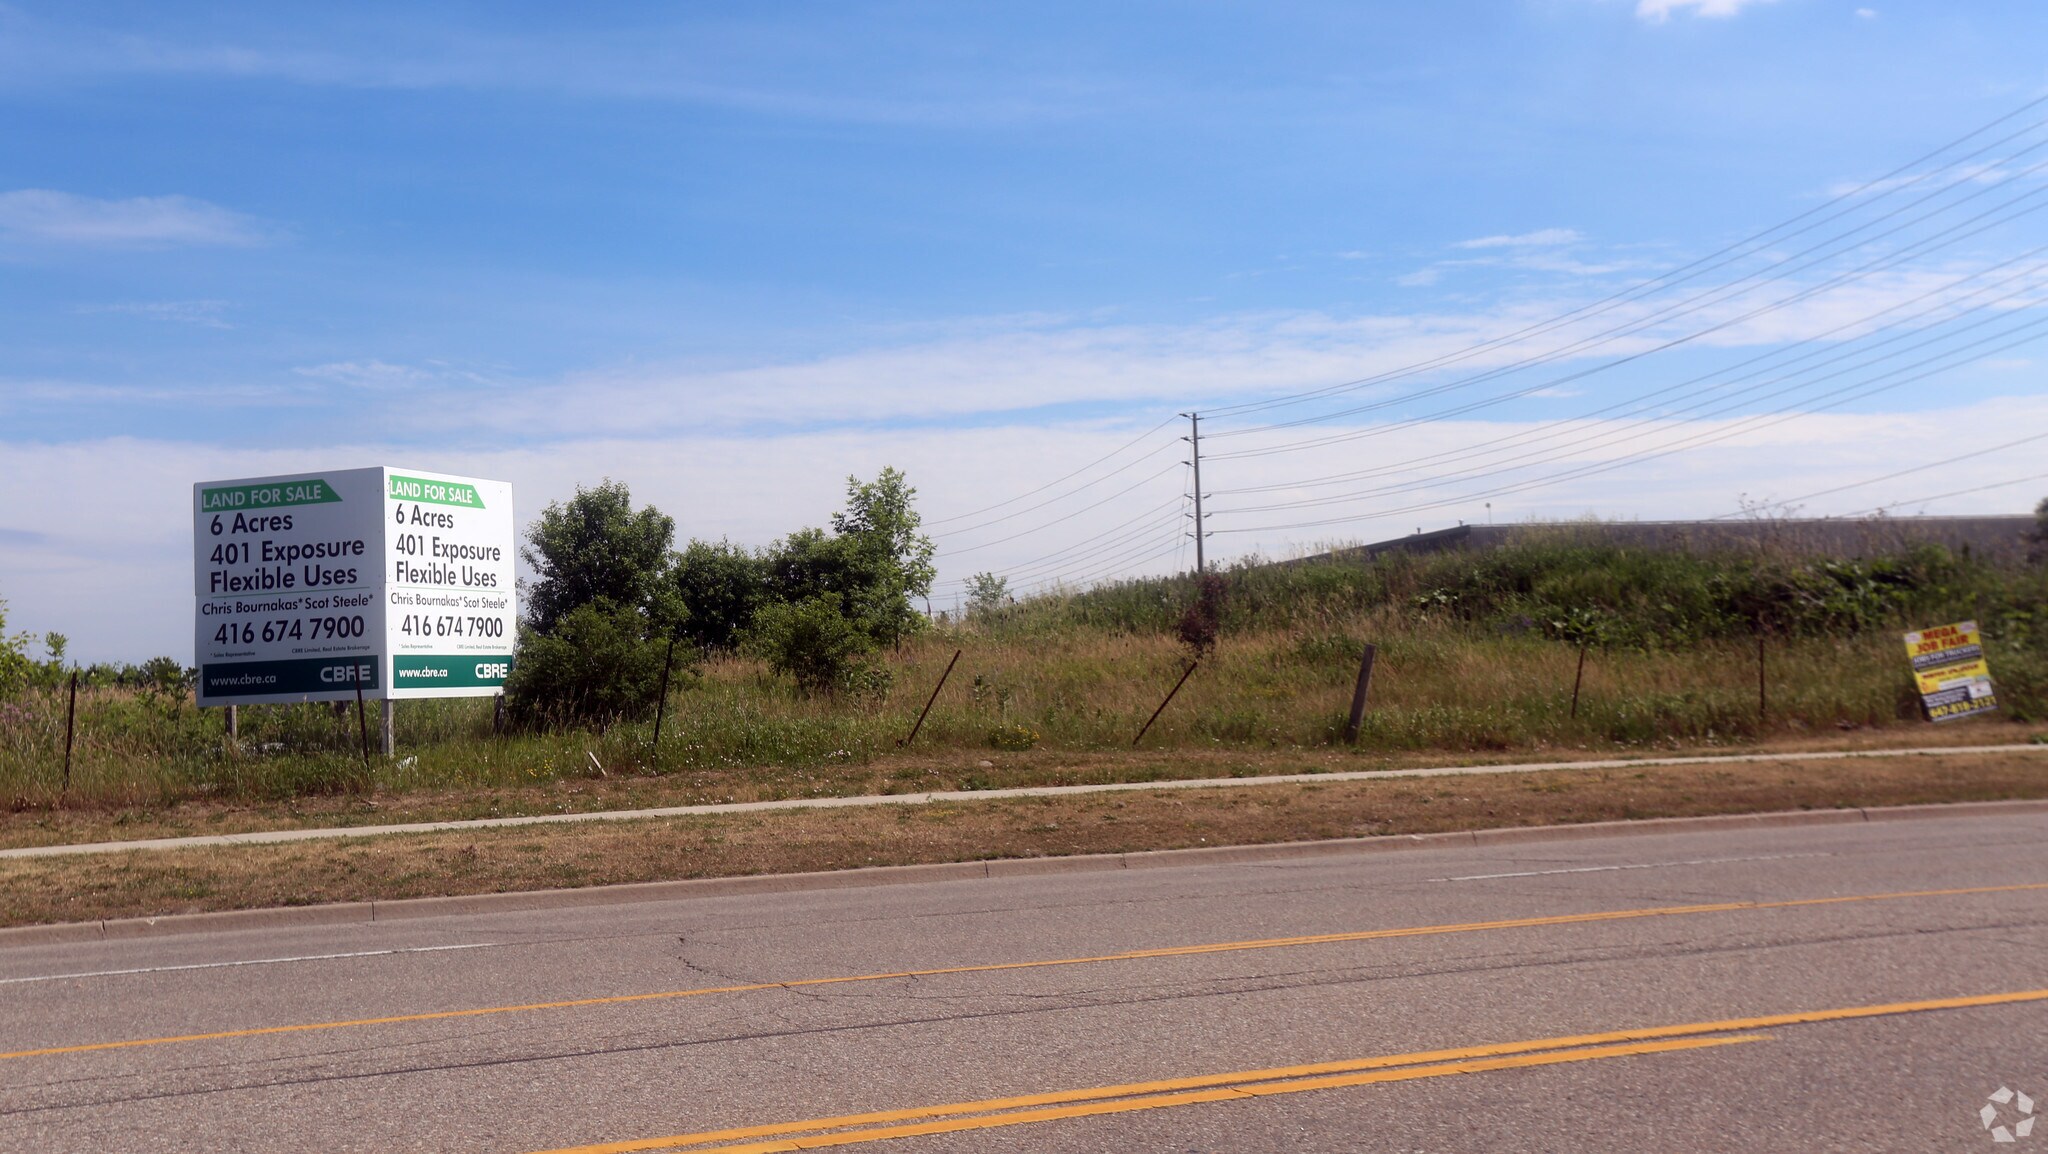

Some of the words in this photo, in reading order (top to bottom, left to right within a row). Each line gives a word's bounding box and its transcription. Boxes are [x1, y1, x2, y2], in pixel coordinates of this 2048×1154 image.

[203, 491, 245, 509] LAND
[251, 489, 281, 505] FOR
[286, 485, 322, 501] SALE
[390, 480, 421, 498] LAND
[424, 484, 446, 501] FOR
[448, 486, 473, 504] SALE
[210, 514, 223, 536] 6
[231, 512, 293, 534] Acres
[395, 503, 405, 525] 6
[410, 504, 454, 529] Acres
[210, 542, 249, 565] 401
[261, 539, 365, 566] Exposure
[396, 533, 424, 556] 401
[432, 536, 501, 564] Exposure
[210, 566, 295, 593] Flexible
[304, 564, 358, 587] Uses
[396, 560, 457, 585] Flexible
[462, 565, 497, 587] Uses
[202, 602, 232, 616] Chris
[305, 597, 329, 610] Scot
[390, 592, 413, 606] Chris
[463, 596, 480, 608] Scot
[214, 622, 255, 645] 416
[262, 619, 303, 643] 674
[310, 615, 365, 640] 7900
[401, 614, 432, 637] 416
[436, 616, 463, 637] 674
[467, 616, 503, 638] 7900
[1922, 626, 1958, 641] MEGA
[1917, 641, 1939, 653] JOB
[1941, 634, 1969, 649] FAIR
[210, 674, 277, 687] www.cbre.ca
[319, 664, 371, 683] CBRE
[398, 666, 448, 678] www.cbre.ca
[475, 663, 508, 679] CBRE
